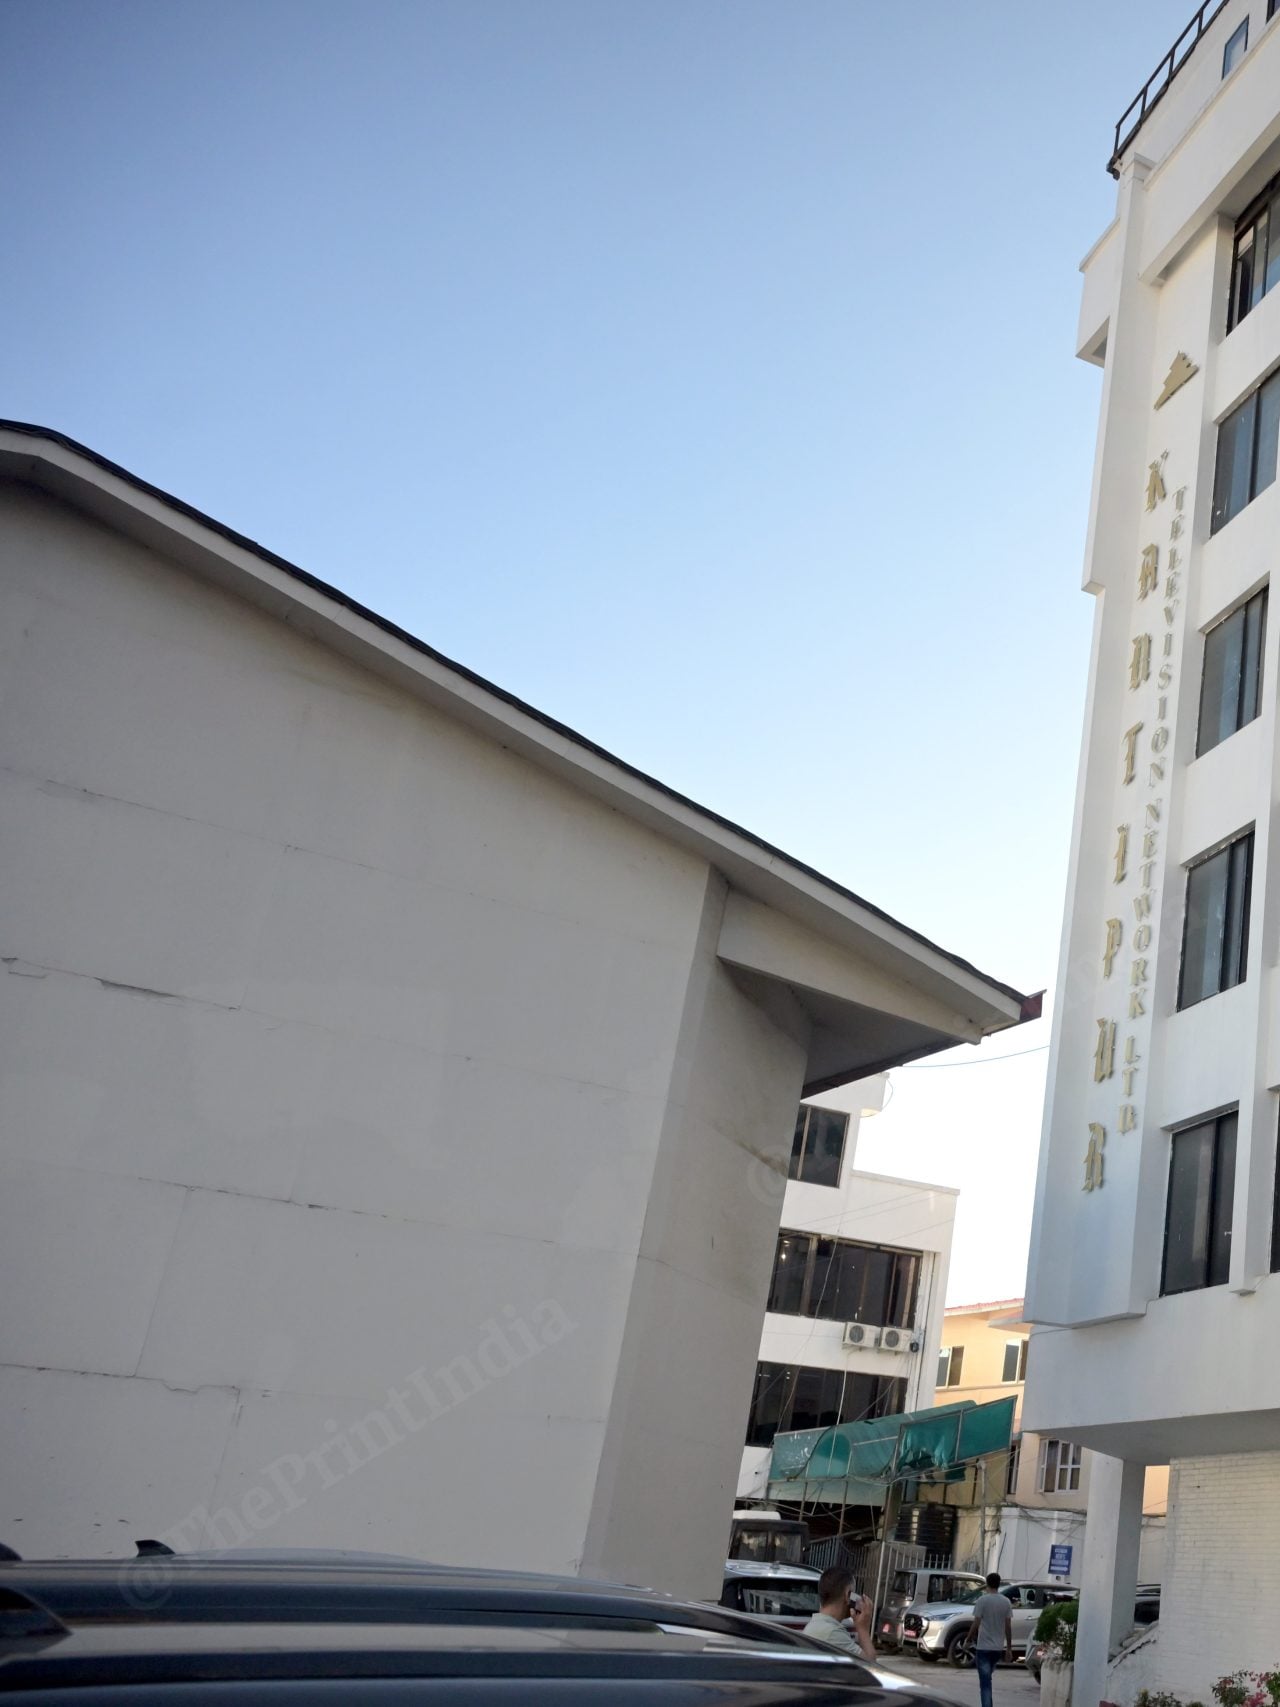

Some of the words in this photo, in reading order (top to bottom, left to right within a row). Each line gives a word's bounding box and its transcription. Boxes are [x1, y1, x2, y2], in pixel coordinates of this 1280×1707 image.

[1149, 487, 1186, 788] TELEVISION
[1081, 449, 1169, 1192] KANTIPUR
[1130, 798, 1163, 1019] NETWORK
[1116, 1035, 1141, 1137] LTD
